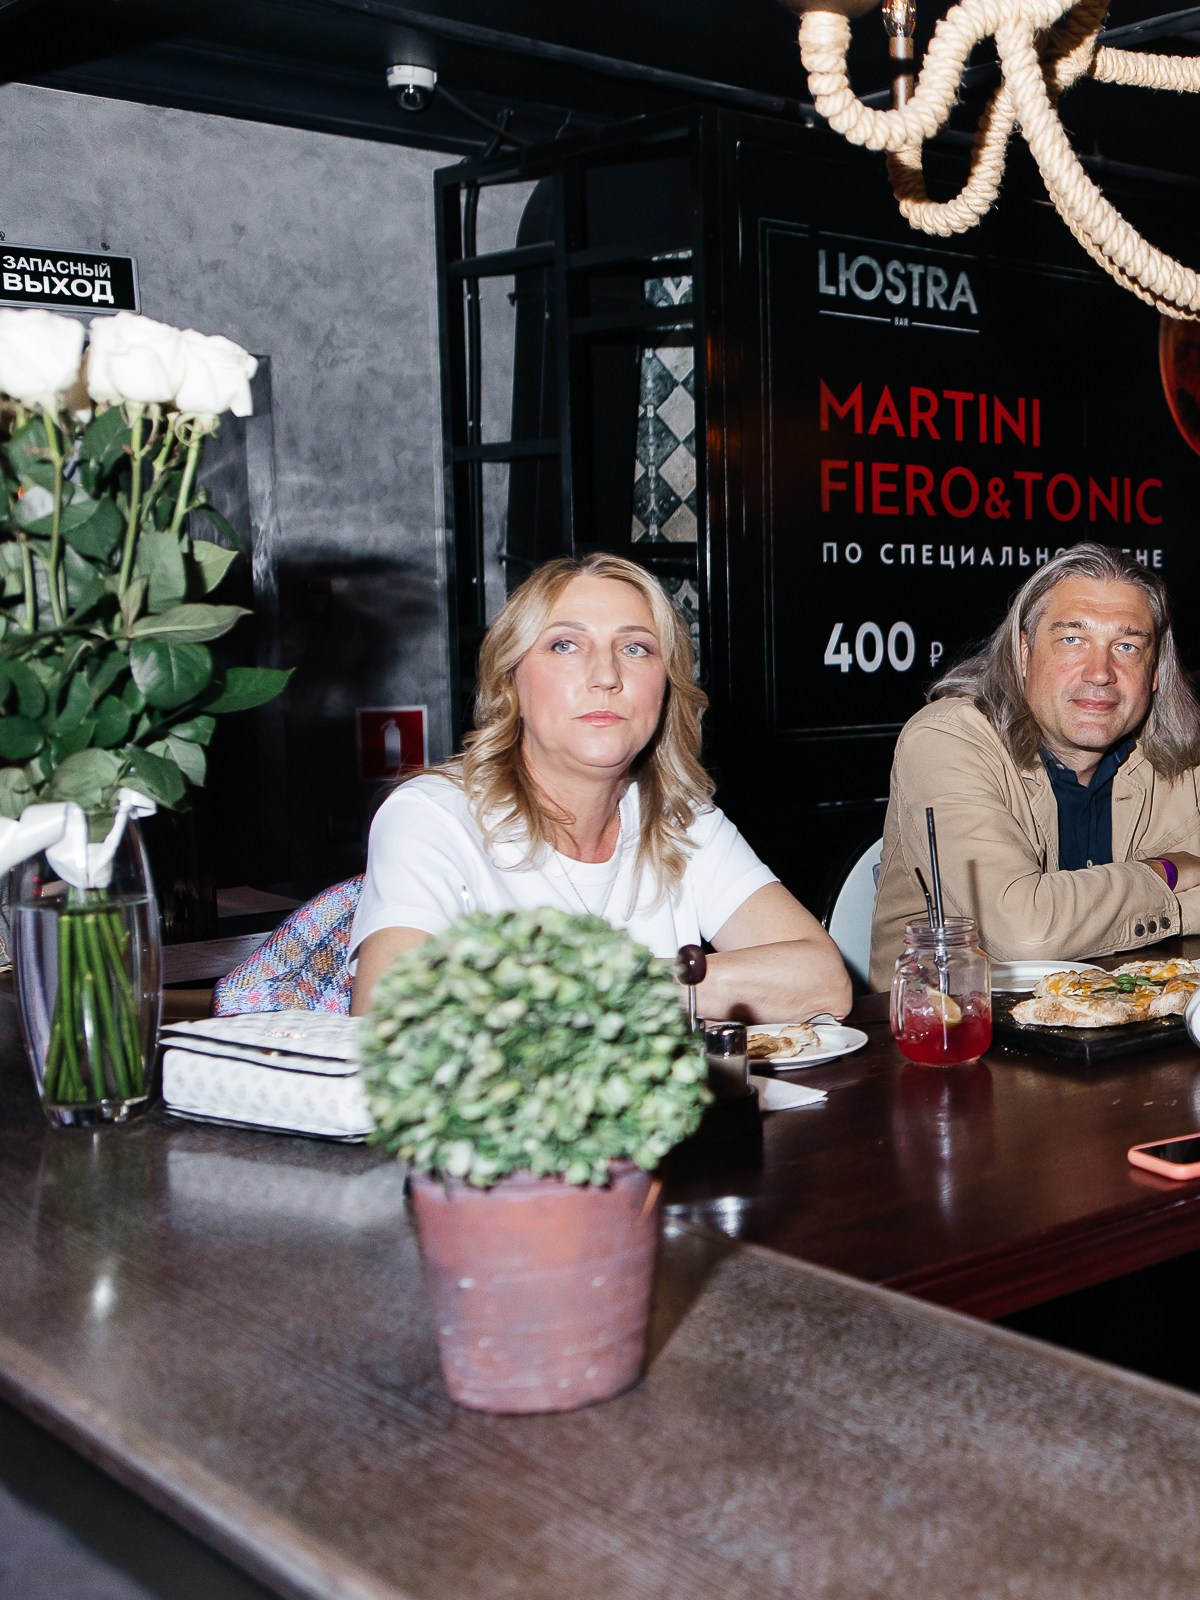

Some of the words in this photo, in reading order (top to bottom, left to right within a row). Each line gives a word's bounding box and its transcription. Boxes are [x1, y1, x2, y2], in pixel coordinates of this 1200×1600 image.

[3, 255, 111, 278] ЗАПАСНЫЙ
[3, 272, 114, 304] ВЫХОД
[820, 377, 1041, 447] MARTINI
[820, 459, 1163, 525] FIERO&TONIC
[823, 542, 862, 564] ПО
[880, 543, 1067, 569] СПЕЦИАЛЬН
[824, 621, 915, 673] 400
